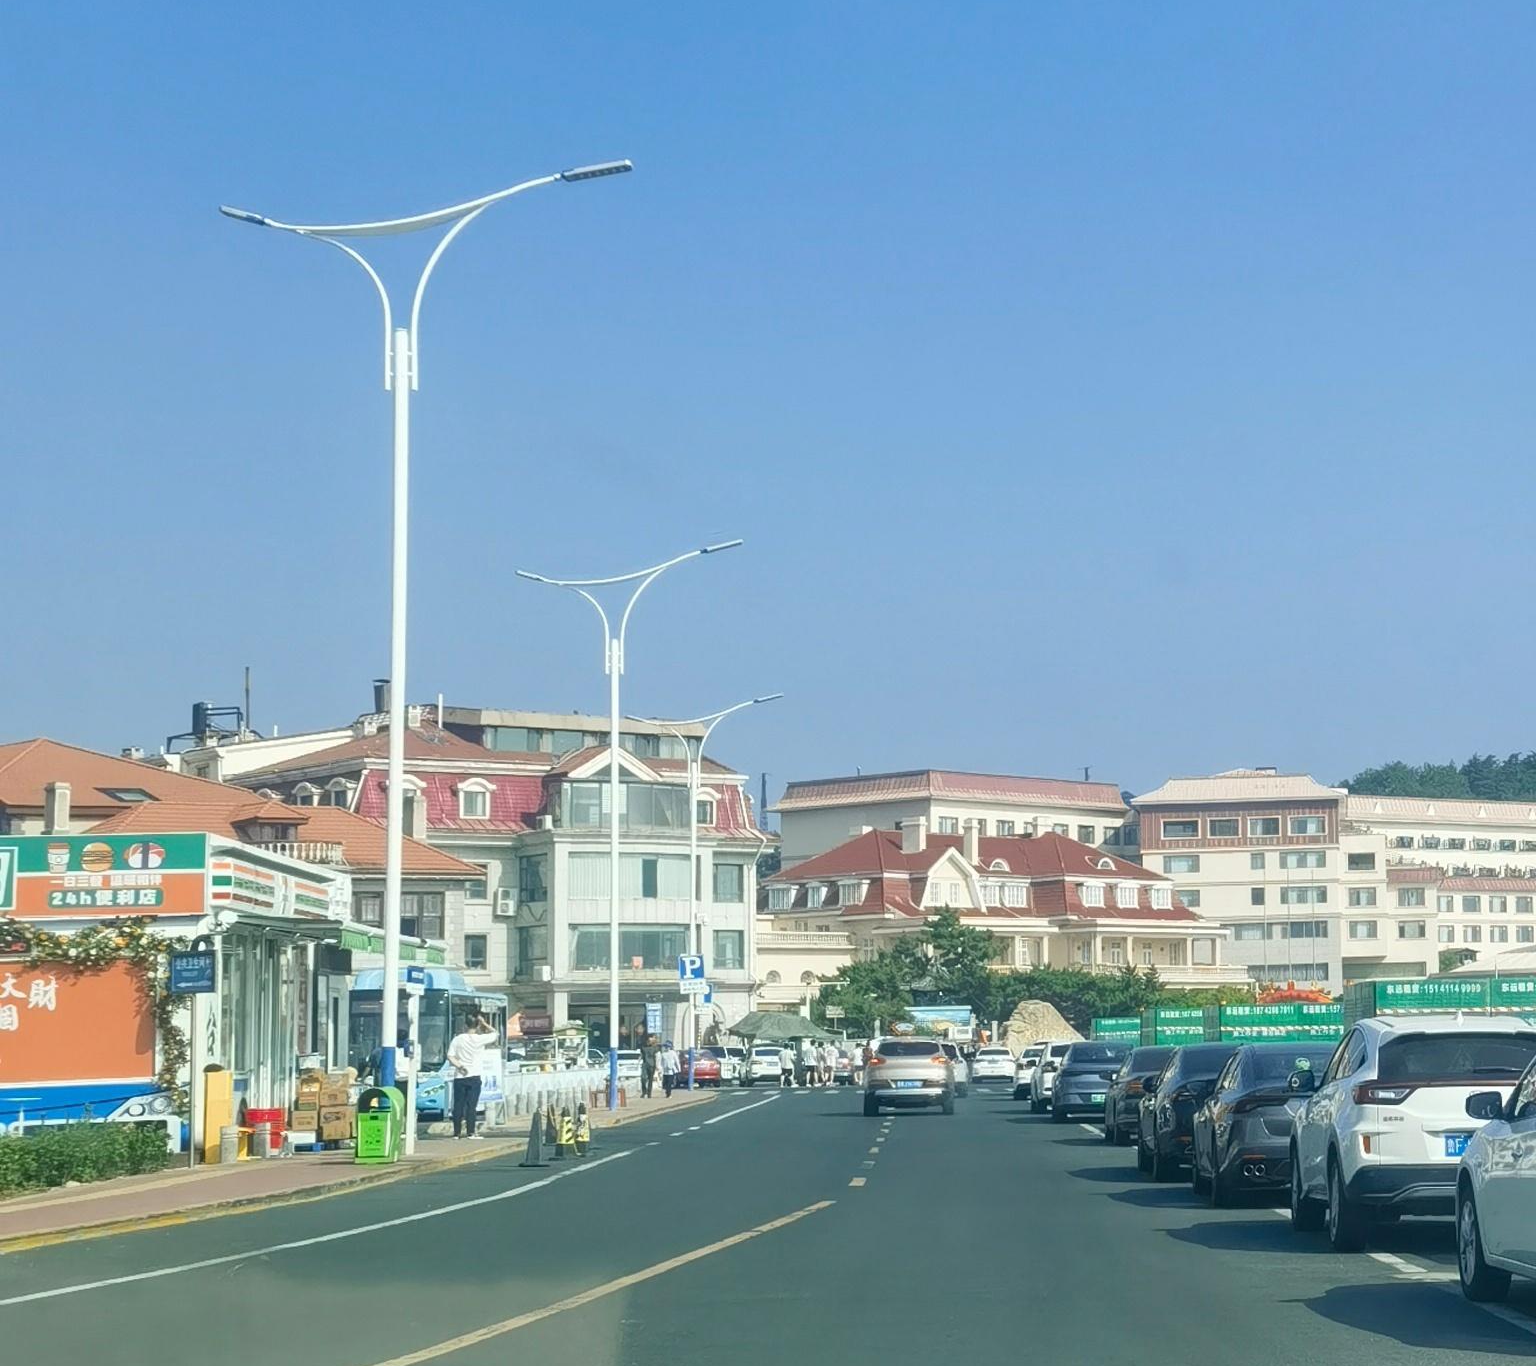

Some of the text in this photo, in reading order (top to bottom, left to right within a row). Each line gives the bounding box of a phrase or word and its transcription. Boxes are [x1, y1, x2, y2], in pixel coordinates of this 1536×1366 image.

[51, 889, 157, 906] 24h便利店
[682, 956, 701, 979] P
